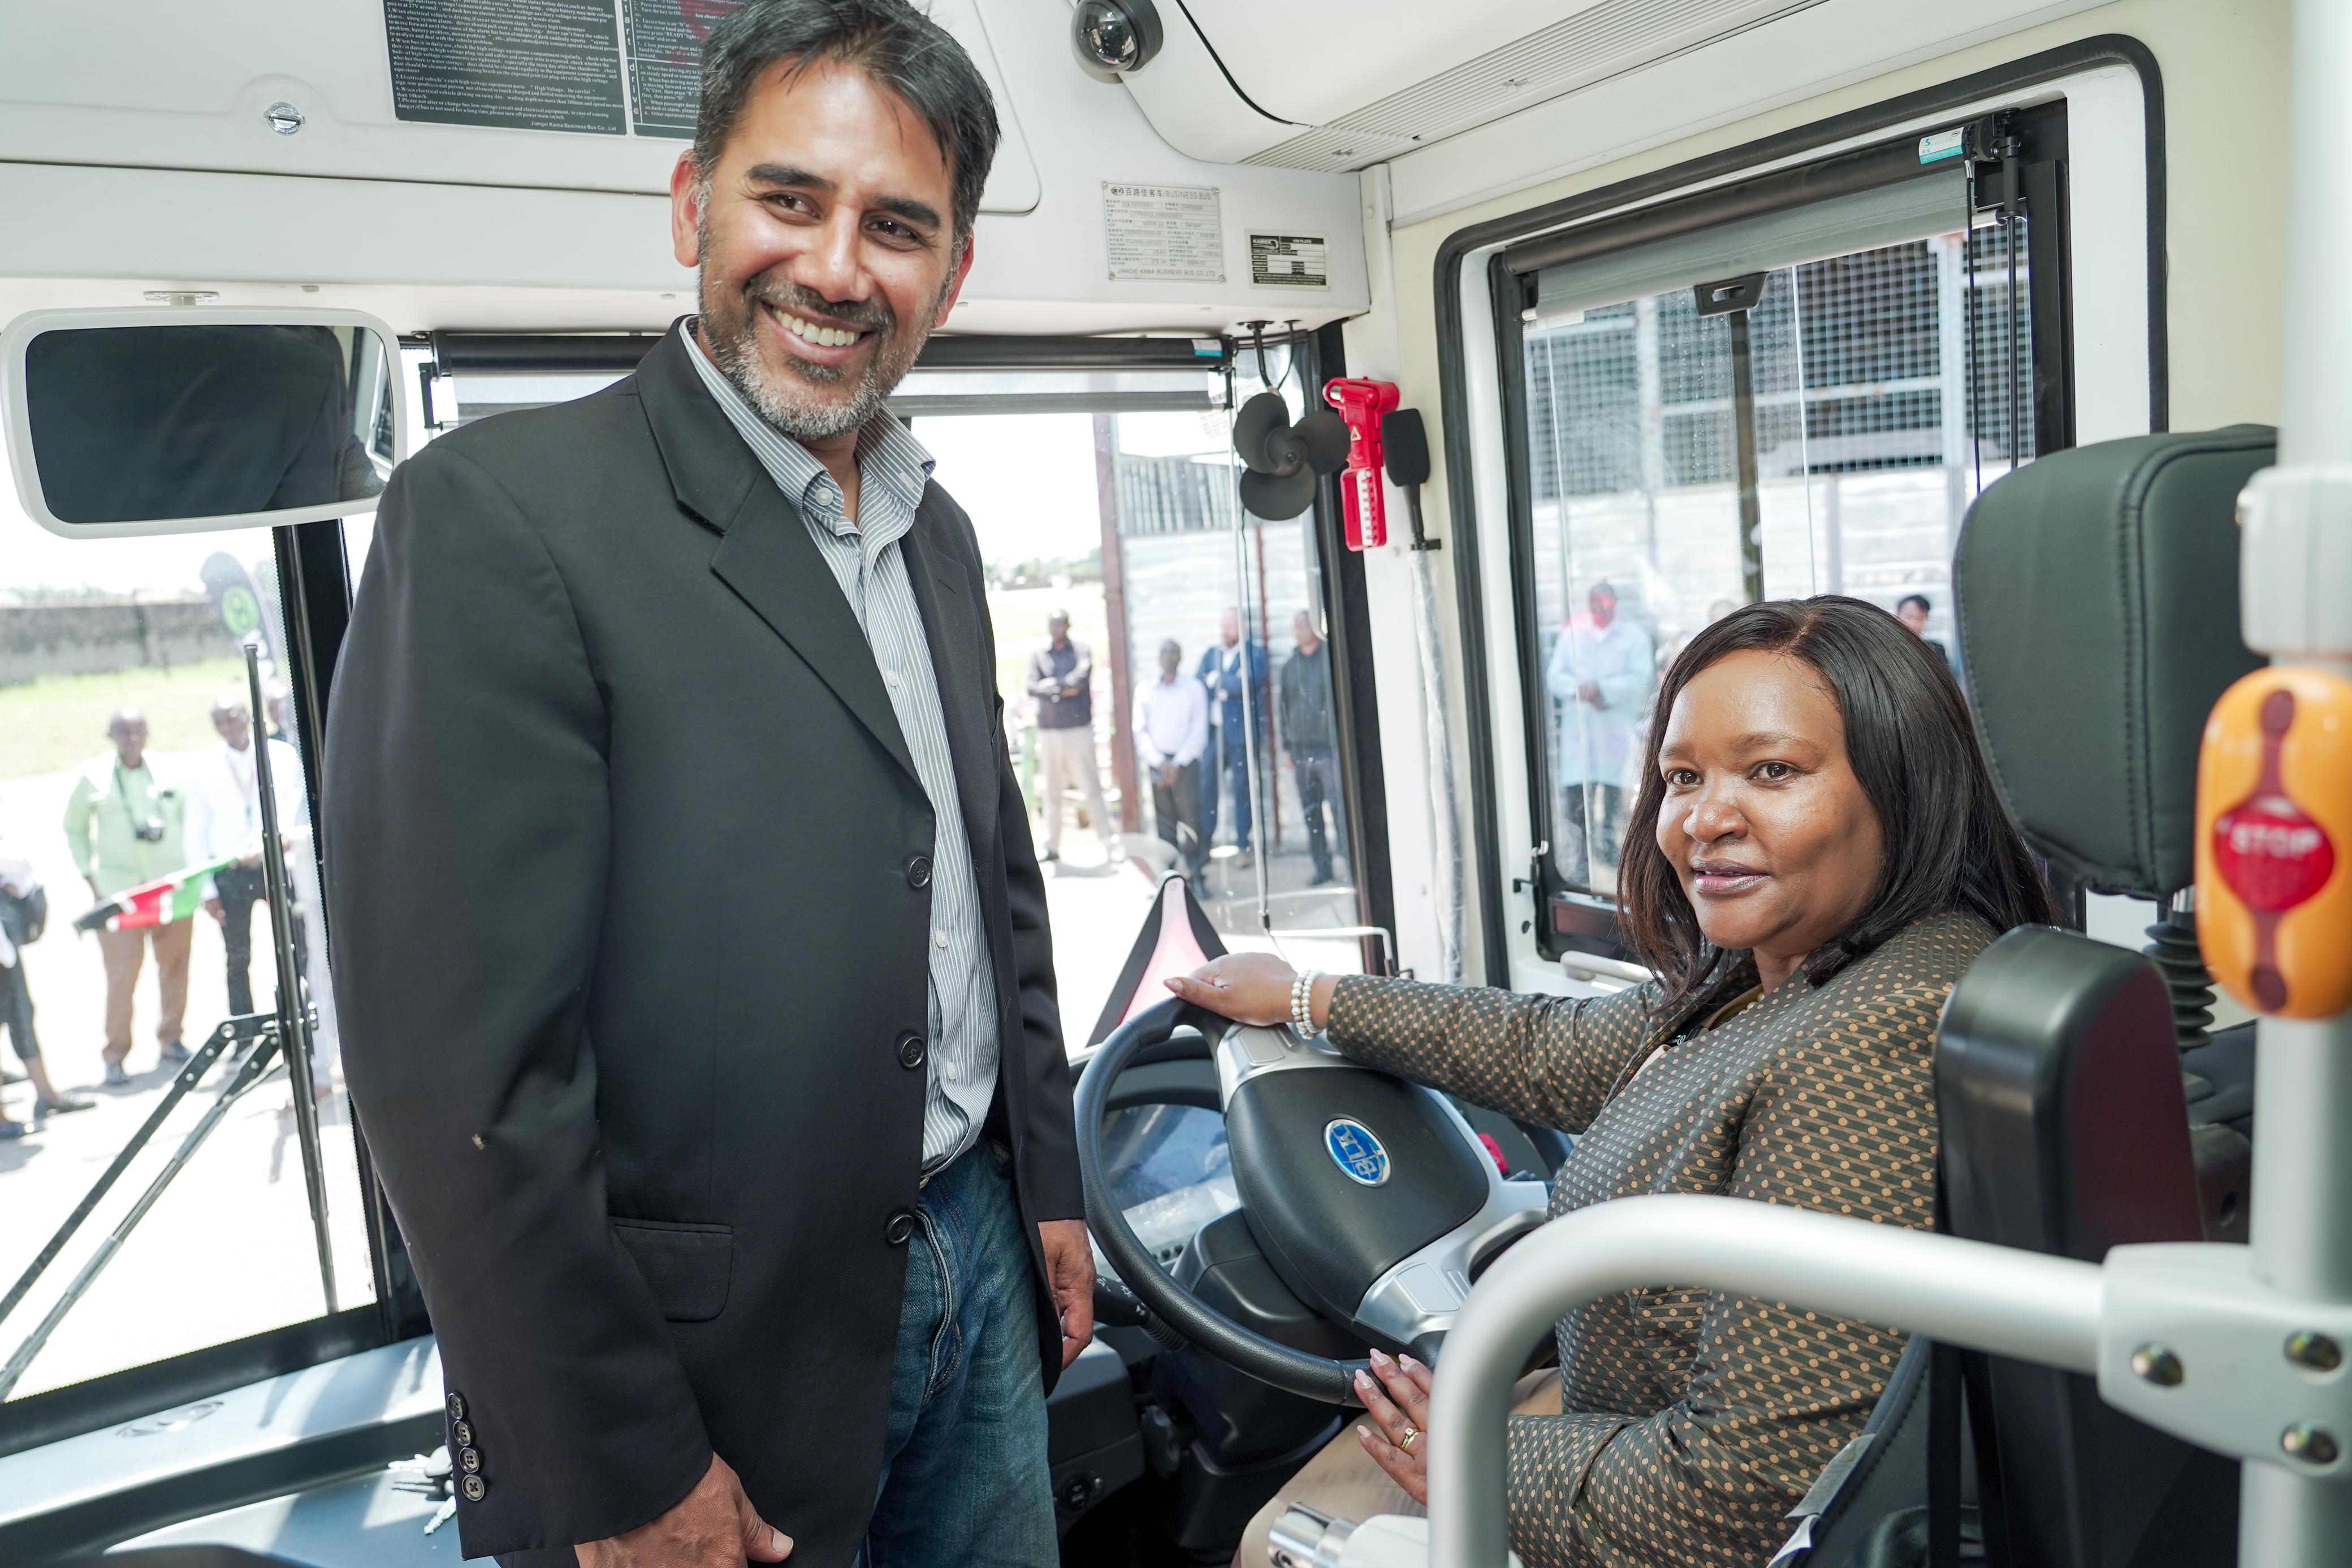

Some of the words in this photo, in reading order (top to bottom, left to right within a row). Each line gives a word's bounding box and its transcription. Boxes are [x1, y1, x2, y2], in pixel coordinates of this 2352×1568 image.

[629, 63, 639, 114] drive
[1198, 190, 1211, 200] BUS
[2232, 824, 2321, 860] STOP
